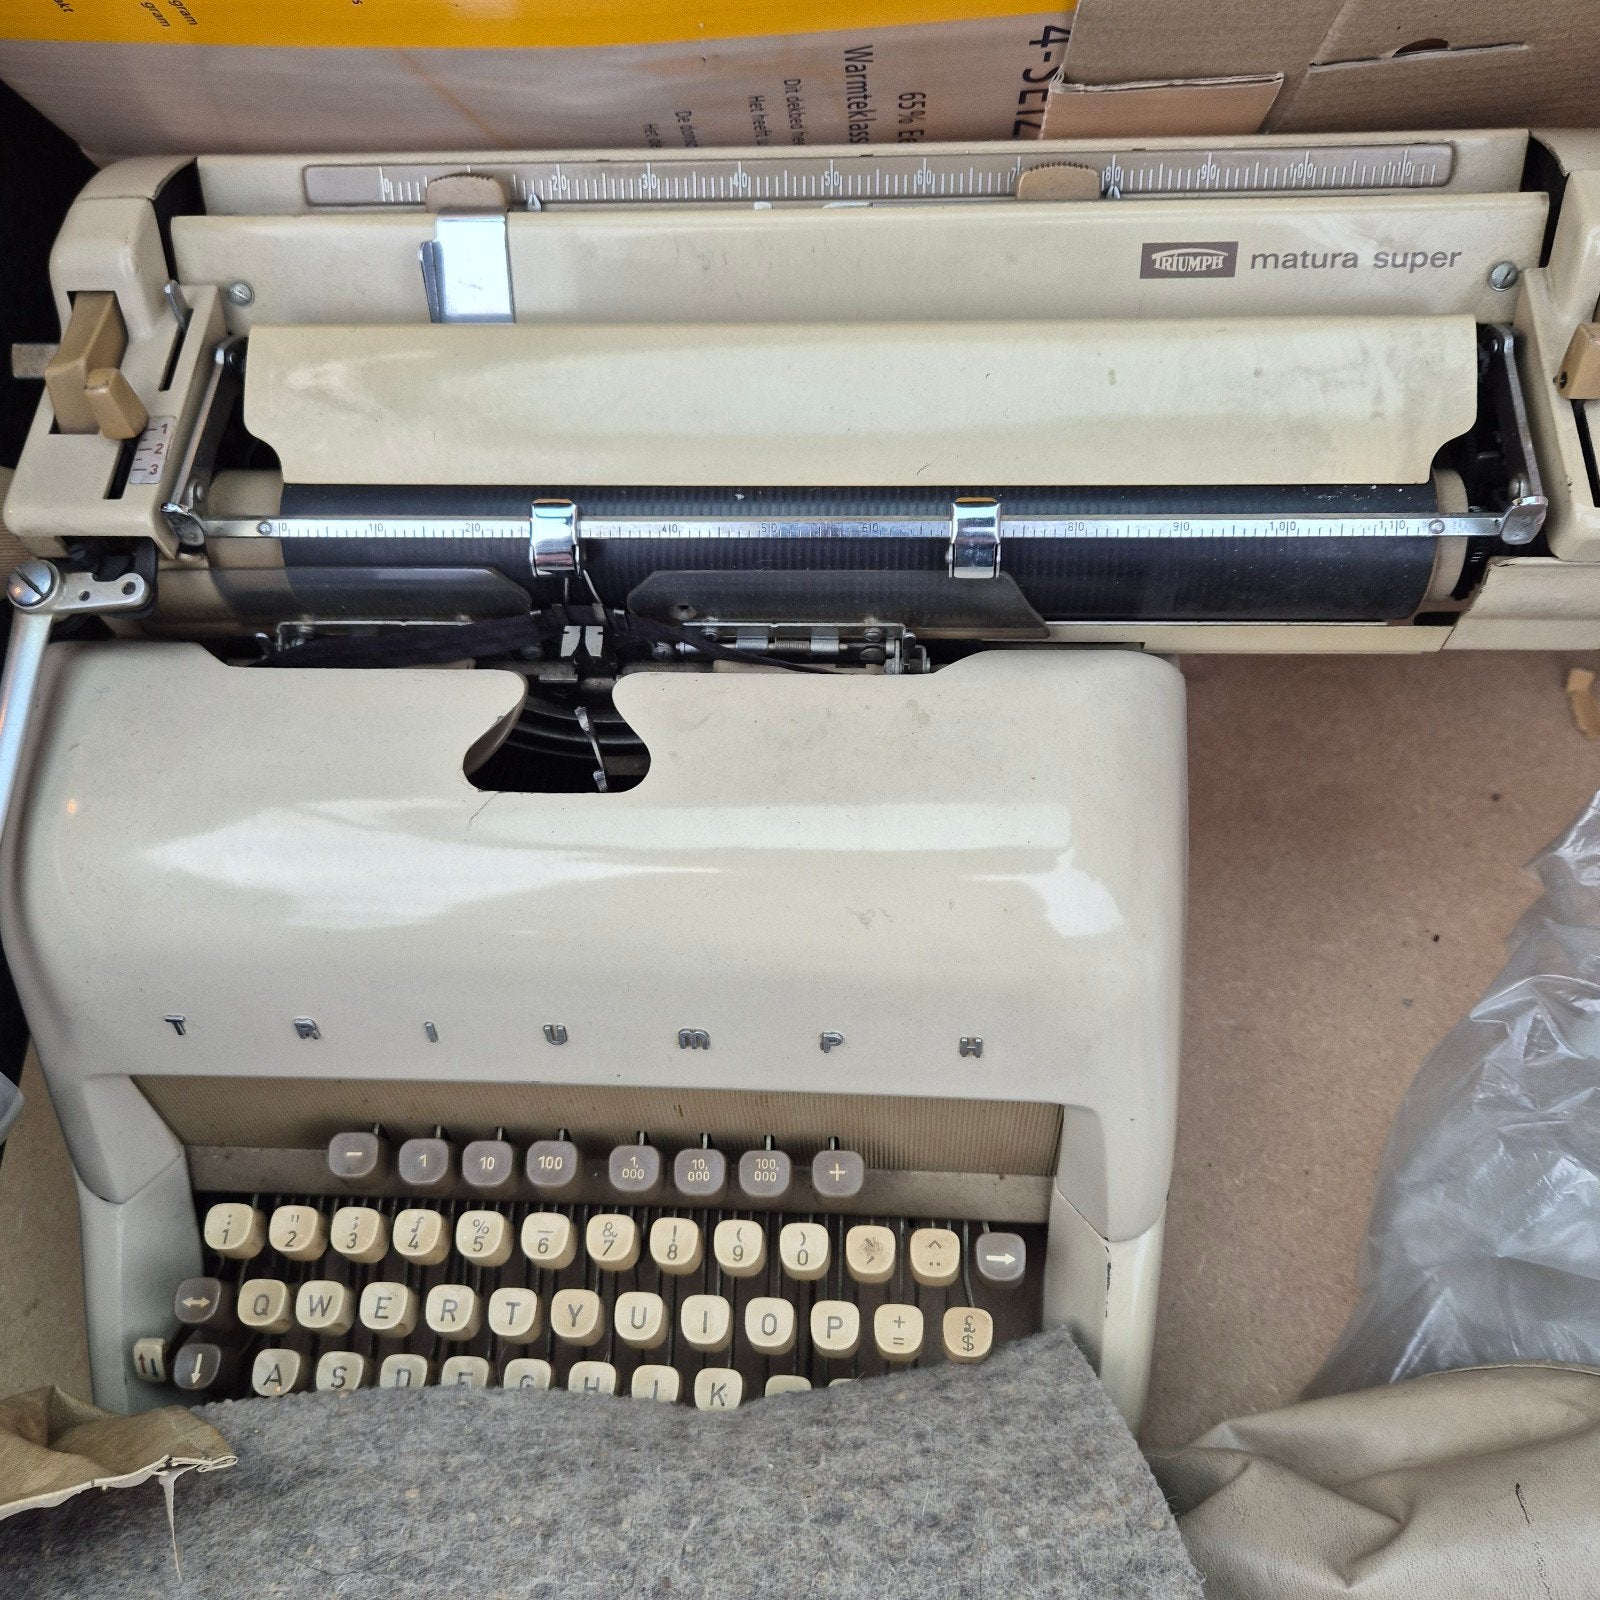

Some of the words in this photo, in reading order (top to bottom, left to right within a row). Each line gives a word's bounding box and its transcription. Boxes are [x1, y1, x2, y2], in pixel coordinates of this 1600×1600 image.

[141, 0, 171, 27] gram
[168, 0, 198, 26] gram
[844, 44, 877, 143] Warmteklass
[898, 91, 926, 124] 65%
[1151, 247, 1228, 273] TRIUMPH
[1250, 250, 1359, 270] matura
[1372, 249, 1462, 273] super
[161, 423, 168, 435] 1
[154, 443, 164, 455] 2
[149, 463, 159, 475] 3
[418, 1153, 428, 1168] 1
[479, 1156, 495, 1170] 10
[538, 1156, 563, 1171] 100
[621, 1168, 646, 1179] 000
[687, 1171, 711, 1182] 000
[754, 1171, 778, 1182] 000
[472, 1218, 490, 1235] %
[602, 1221, 618, 1238] &
[222, 1228, 231, 1245] 1
[284, 1231, 296, 1248] 2
[345, 1232, 358, 1250] 3
[407, 1233, 421, 1250] 4
[472, 1235, 485, 1252] 5
[537, 1237, 549, 1254] 6
[602, 1238, 616, 1257] 7
[666, 1243, 678, 1261] 8
[732, 1244, 744, 1262] 9
[252, 1293, 269, 1316] Q
[308, 1294, 333, 1318] W
[374, 1296, 393, 1319] E
[440, 1298, 458, 1323] R
[505, 1301, 521, 1326] T
[567, 1303, 584, 1328] Y
[630, 1305, 648, 1330] U
[702, 1310, 709, 1334] I
[761, 1312, 778, 1337] O
[826, 1315, 844, 1340] P
[962, 1334, 975, 1352] $
[262, 1362, 283, 1387] A
[330, 1365, 348, 1389] S
[709, 1382, 727, 1407] K
